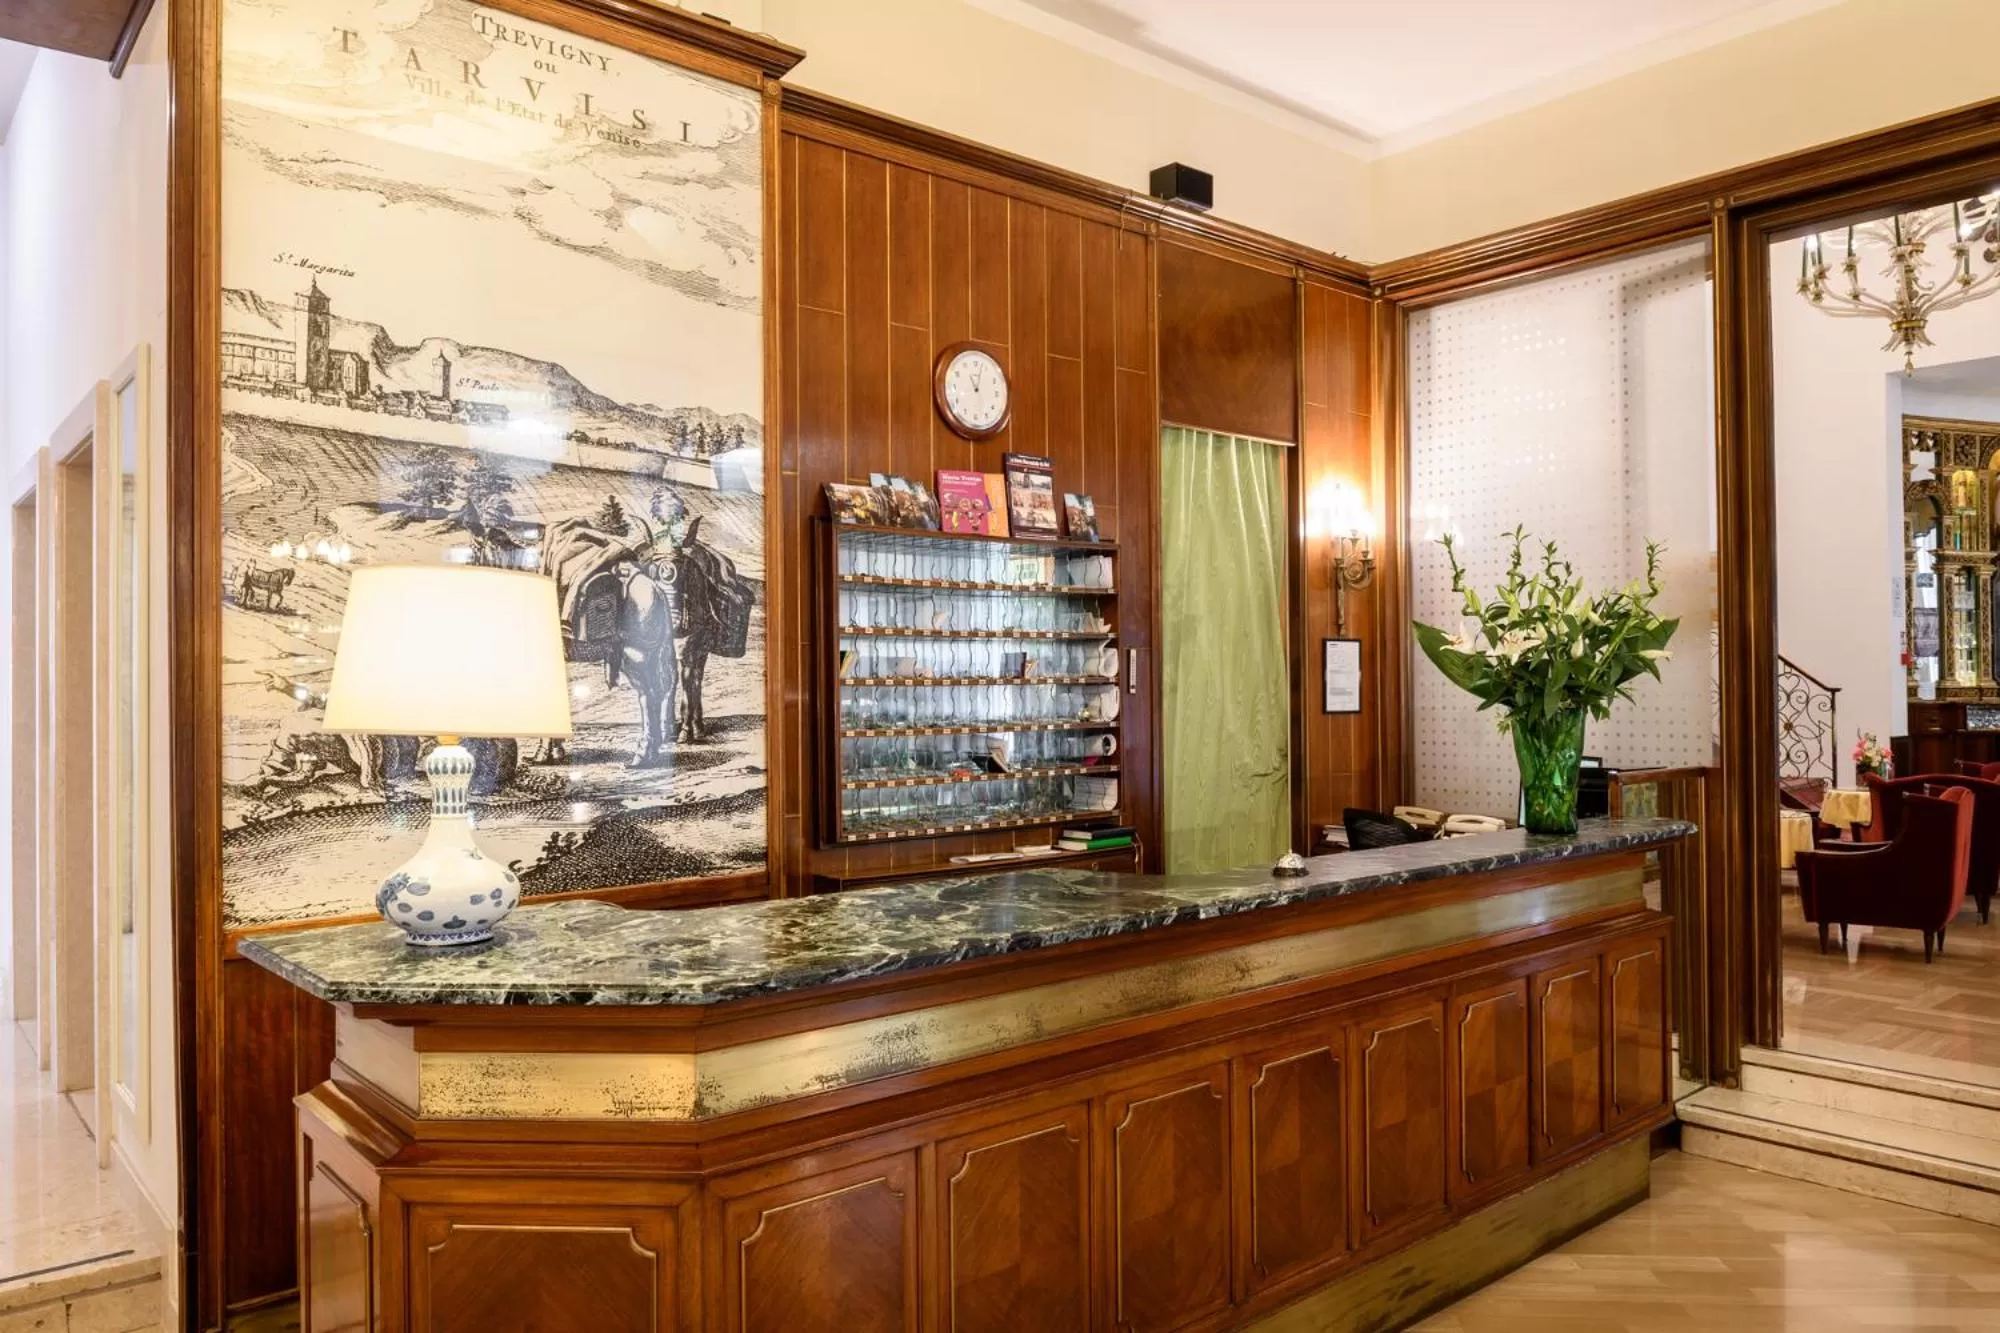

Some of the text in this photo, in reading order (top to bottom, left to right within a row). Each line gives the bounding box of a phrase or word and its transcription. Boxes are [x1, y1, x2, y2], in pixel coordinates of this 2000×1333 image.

[534, 59, 559, 74] ou
[402, 73, 451, 99] Ville
[554, 112, 573, 129] de
